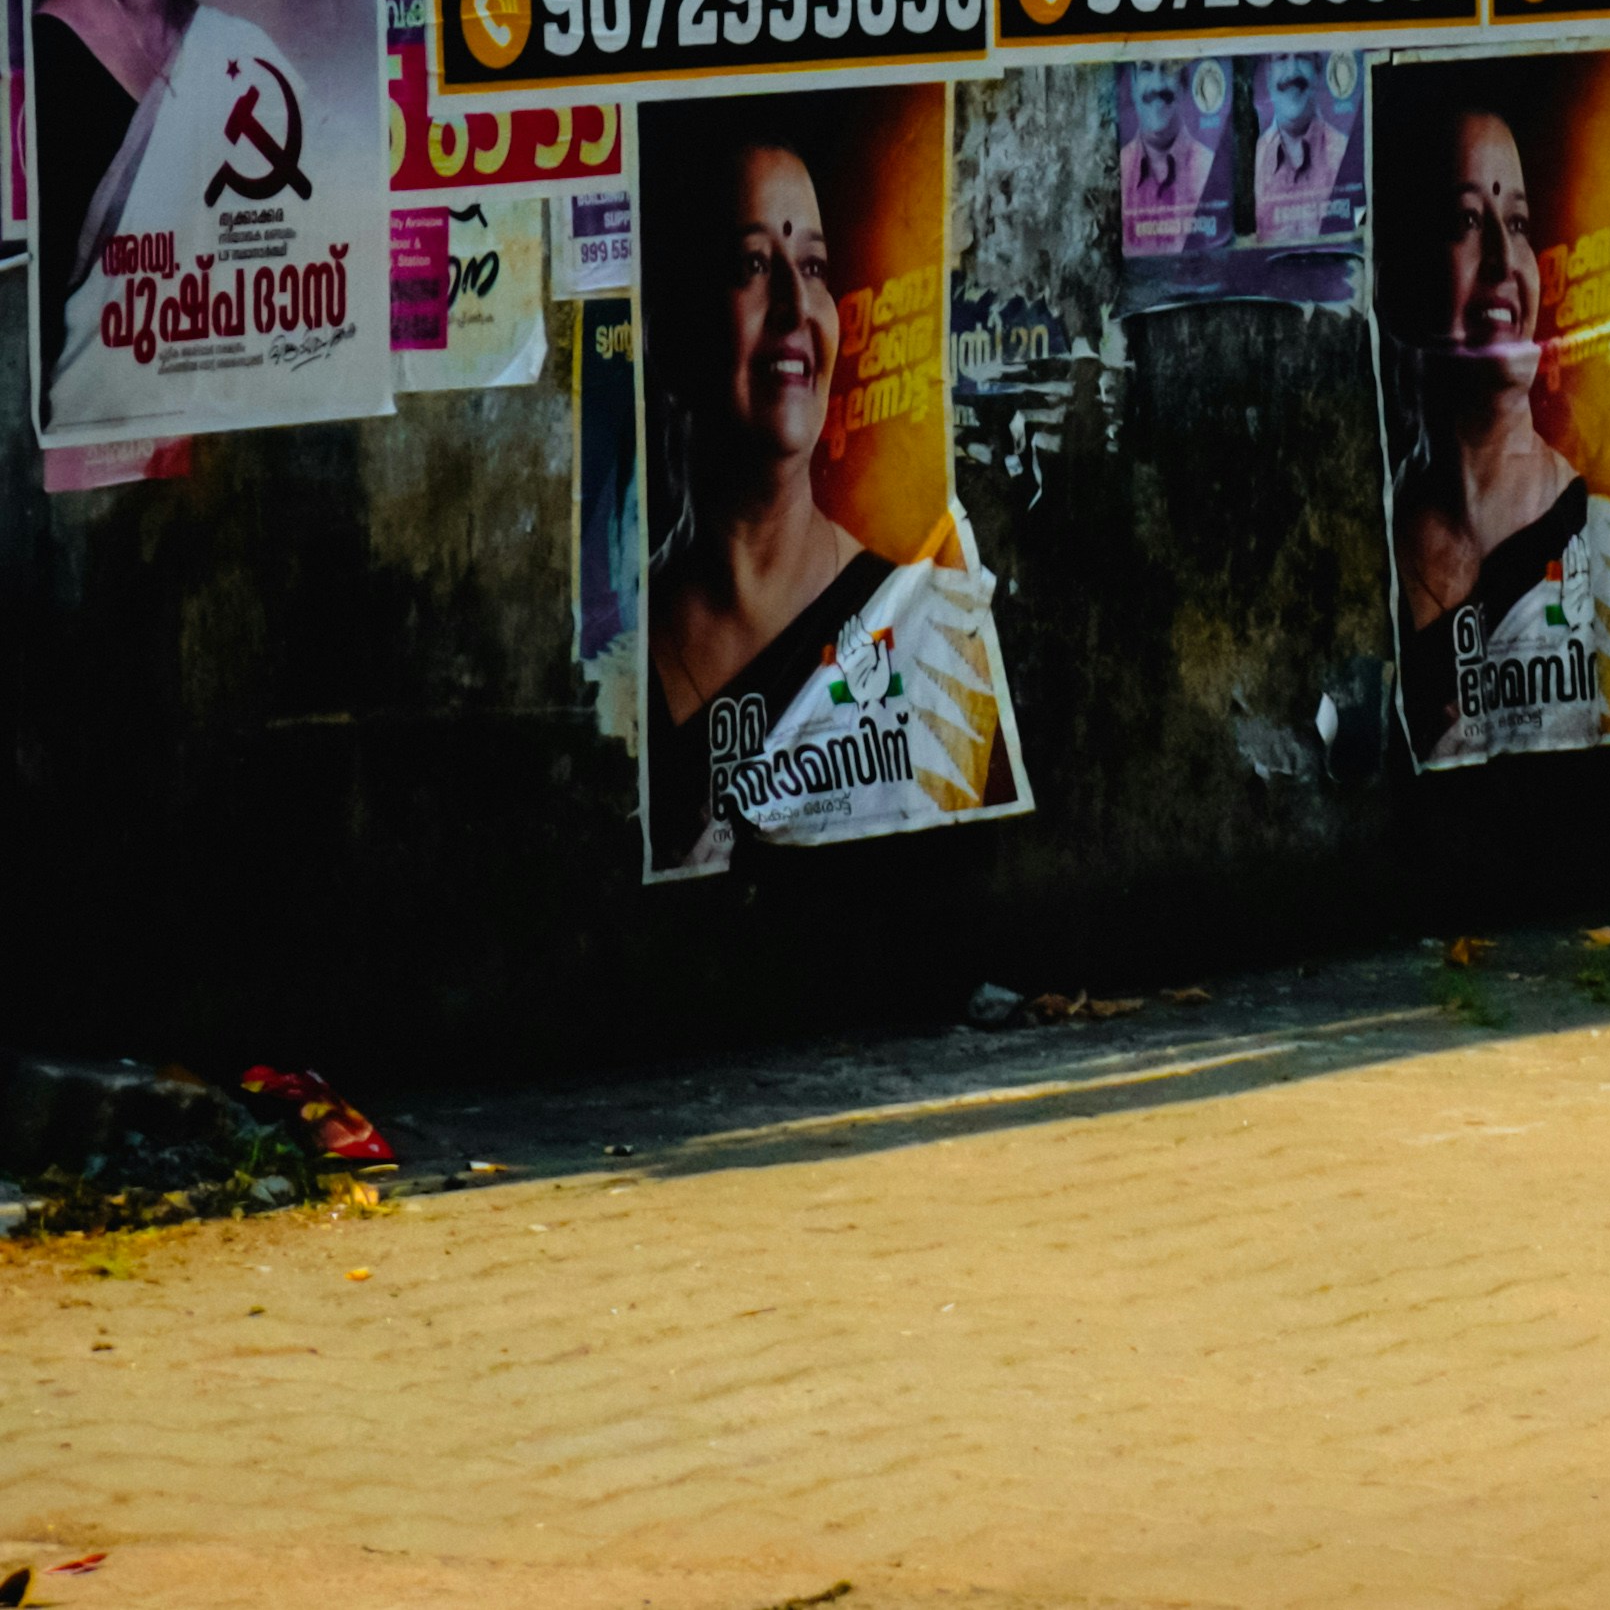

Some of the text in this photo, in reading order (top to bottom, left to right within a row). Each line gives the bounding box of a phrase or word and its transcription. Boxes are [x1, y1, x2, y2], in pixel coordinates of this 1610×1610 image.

[253, 243, 349, 334] ദാസ്
[580, 241, 608, 264] 999
[709, 693, 767, 764] ഉമ
[711, 711, 914, 821] തോമസിന്
